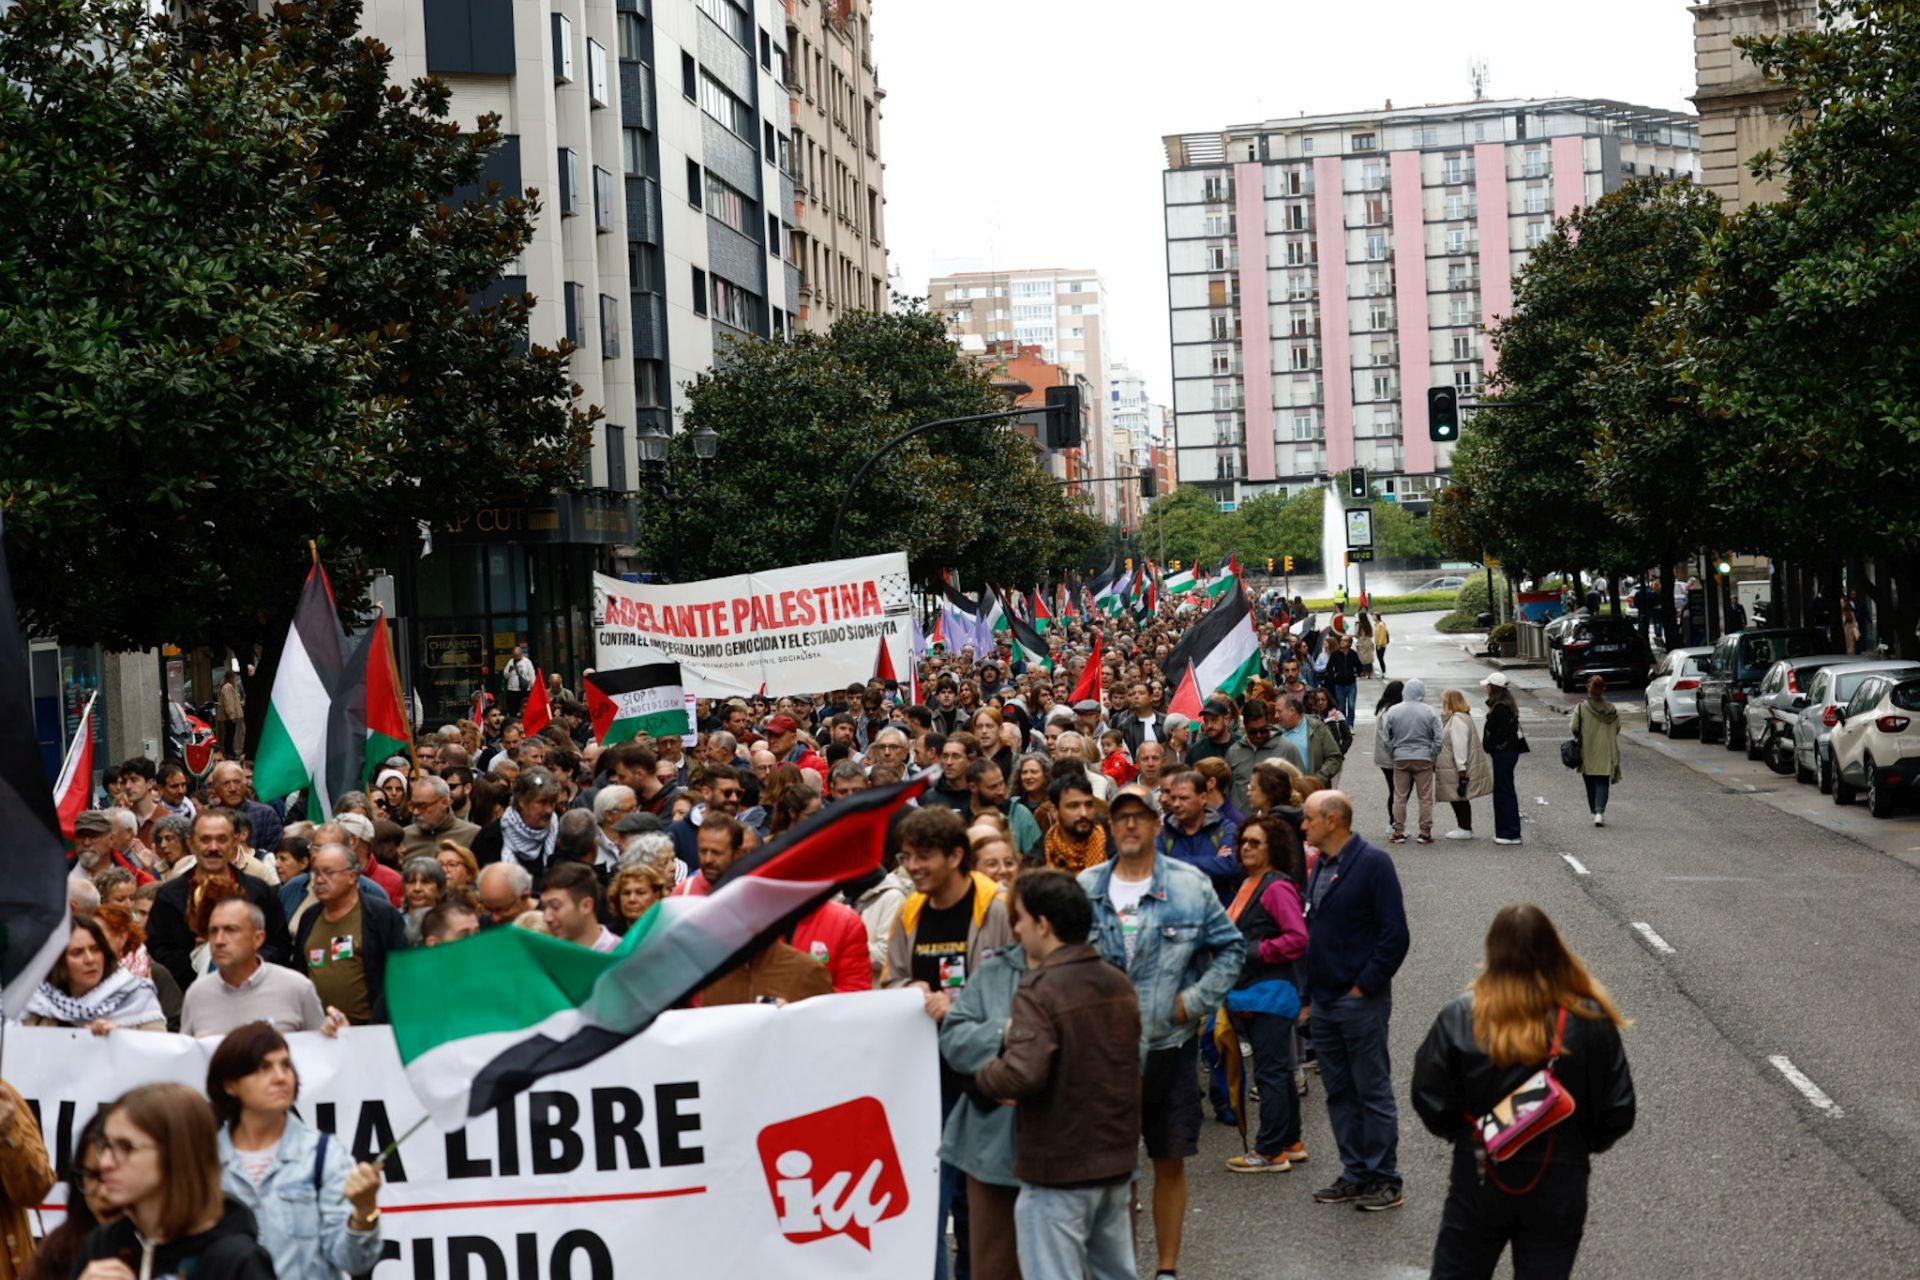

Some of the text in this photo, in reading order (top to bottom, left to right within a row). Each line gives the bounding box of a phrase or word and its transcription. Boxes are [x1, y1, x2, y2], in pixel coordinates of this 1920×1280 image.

[605, 580, 882, 637] ADELANTE PALESTINA
[600, 632, 635, 646] CONTRA
[637, 634, 649, 647] EL
[725, 635, 779, 656] GENOCIDA
[779, 634, 788, 650] Y
[788, 633, 802, 649] EL
[802, 627, 846, 647] ESTADO
[846, 620, 898, 641] SIONISTA
[622, 690, 646, 706] STOP
[445, 1081, 705, 1179] LIBRE
